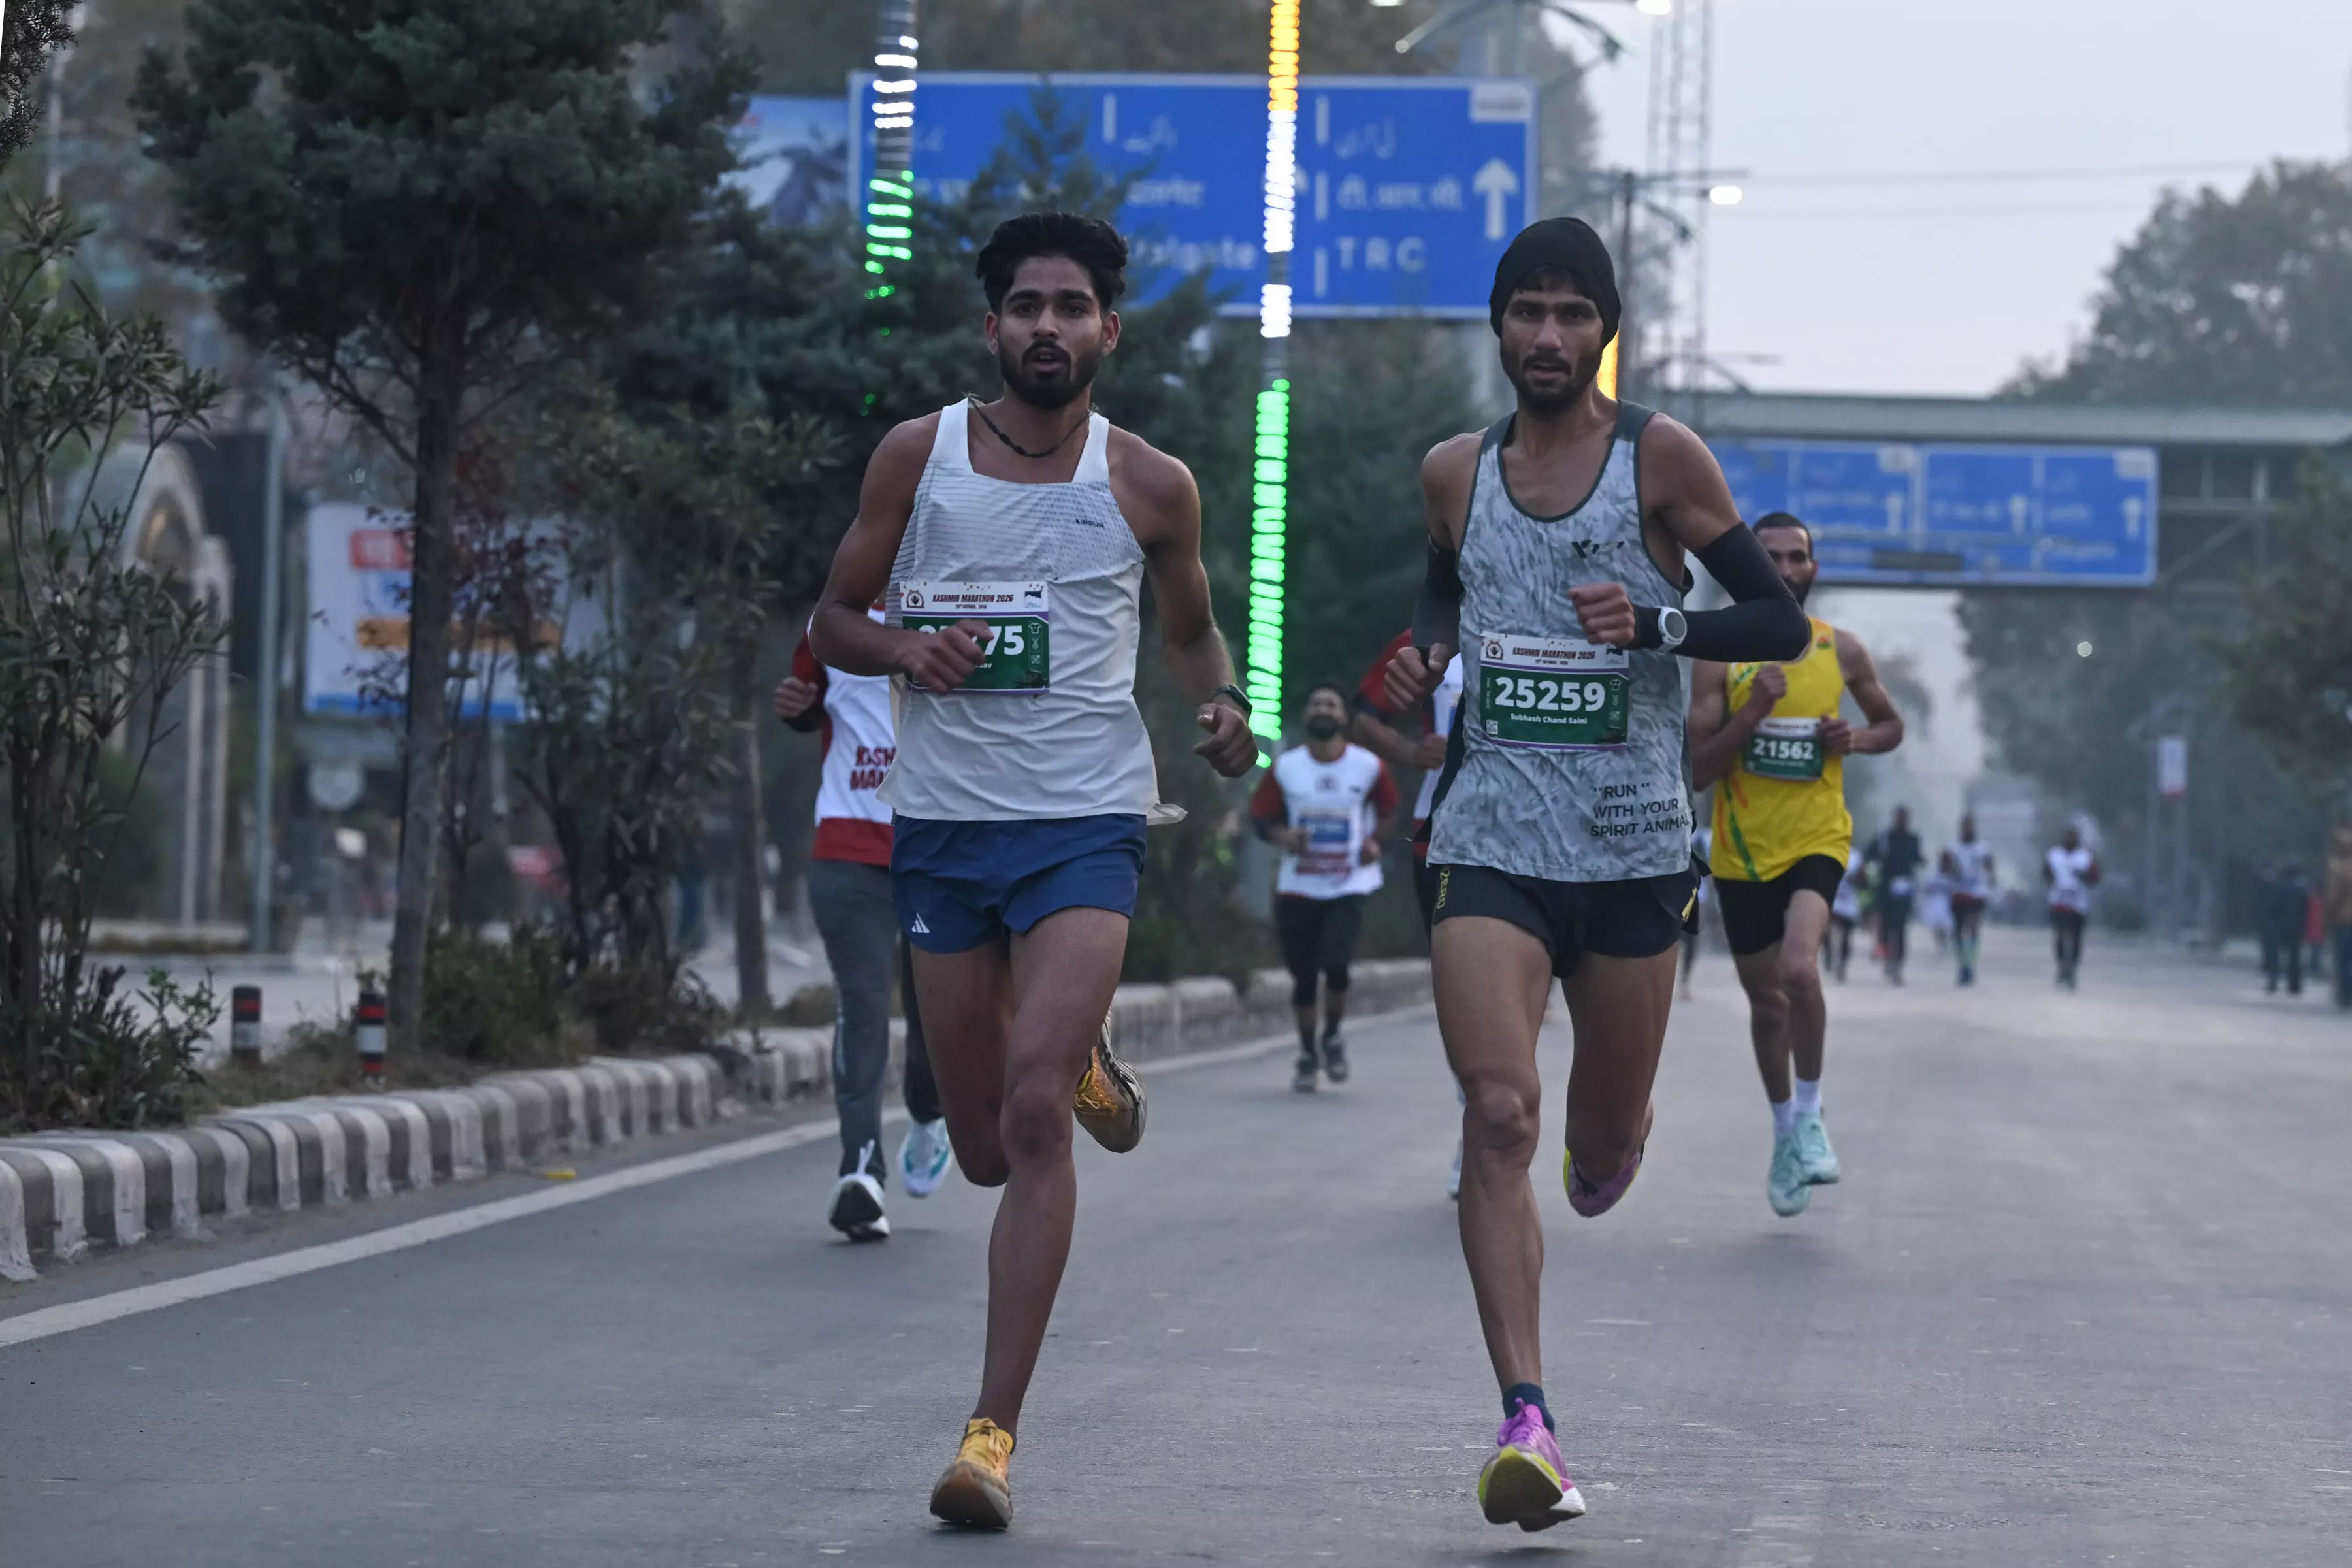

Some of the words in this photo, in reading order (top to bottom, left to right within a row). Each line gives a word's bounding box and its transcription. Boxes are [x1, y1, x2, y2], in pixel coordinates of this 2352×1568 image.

[1512, 647, 1541, 657] KASHMIR
[1541, 649, 1576, 659] MARATHON
[1495, 676, 1605, 711] 25259
[1511, 713, 1542, 723] Subhash
[1753, 738, 1814, 760] 21562
[1593, 804, 1634, 819] WITH
[1639, 798, 1679, 815] YOUR
[1590, 823, 1639, 838] SPIRIT
[1642, 813, 1690, 834] ANIMAL
